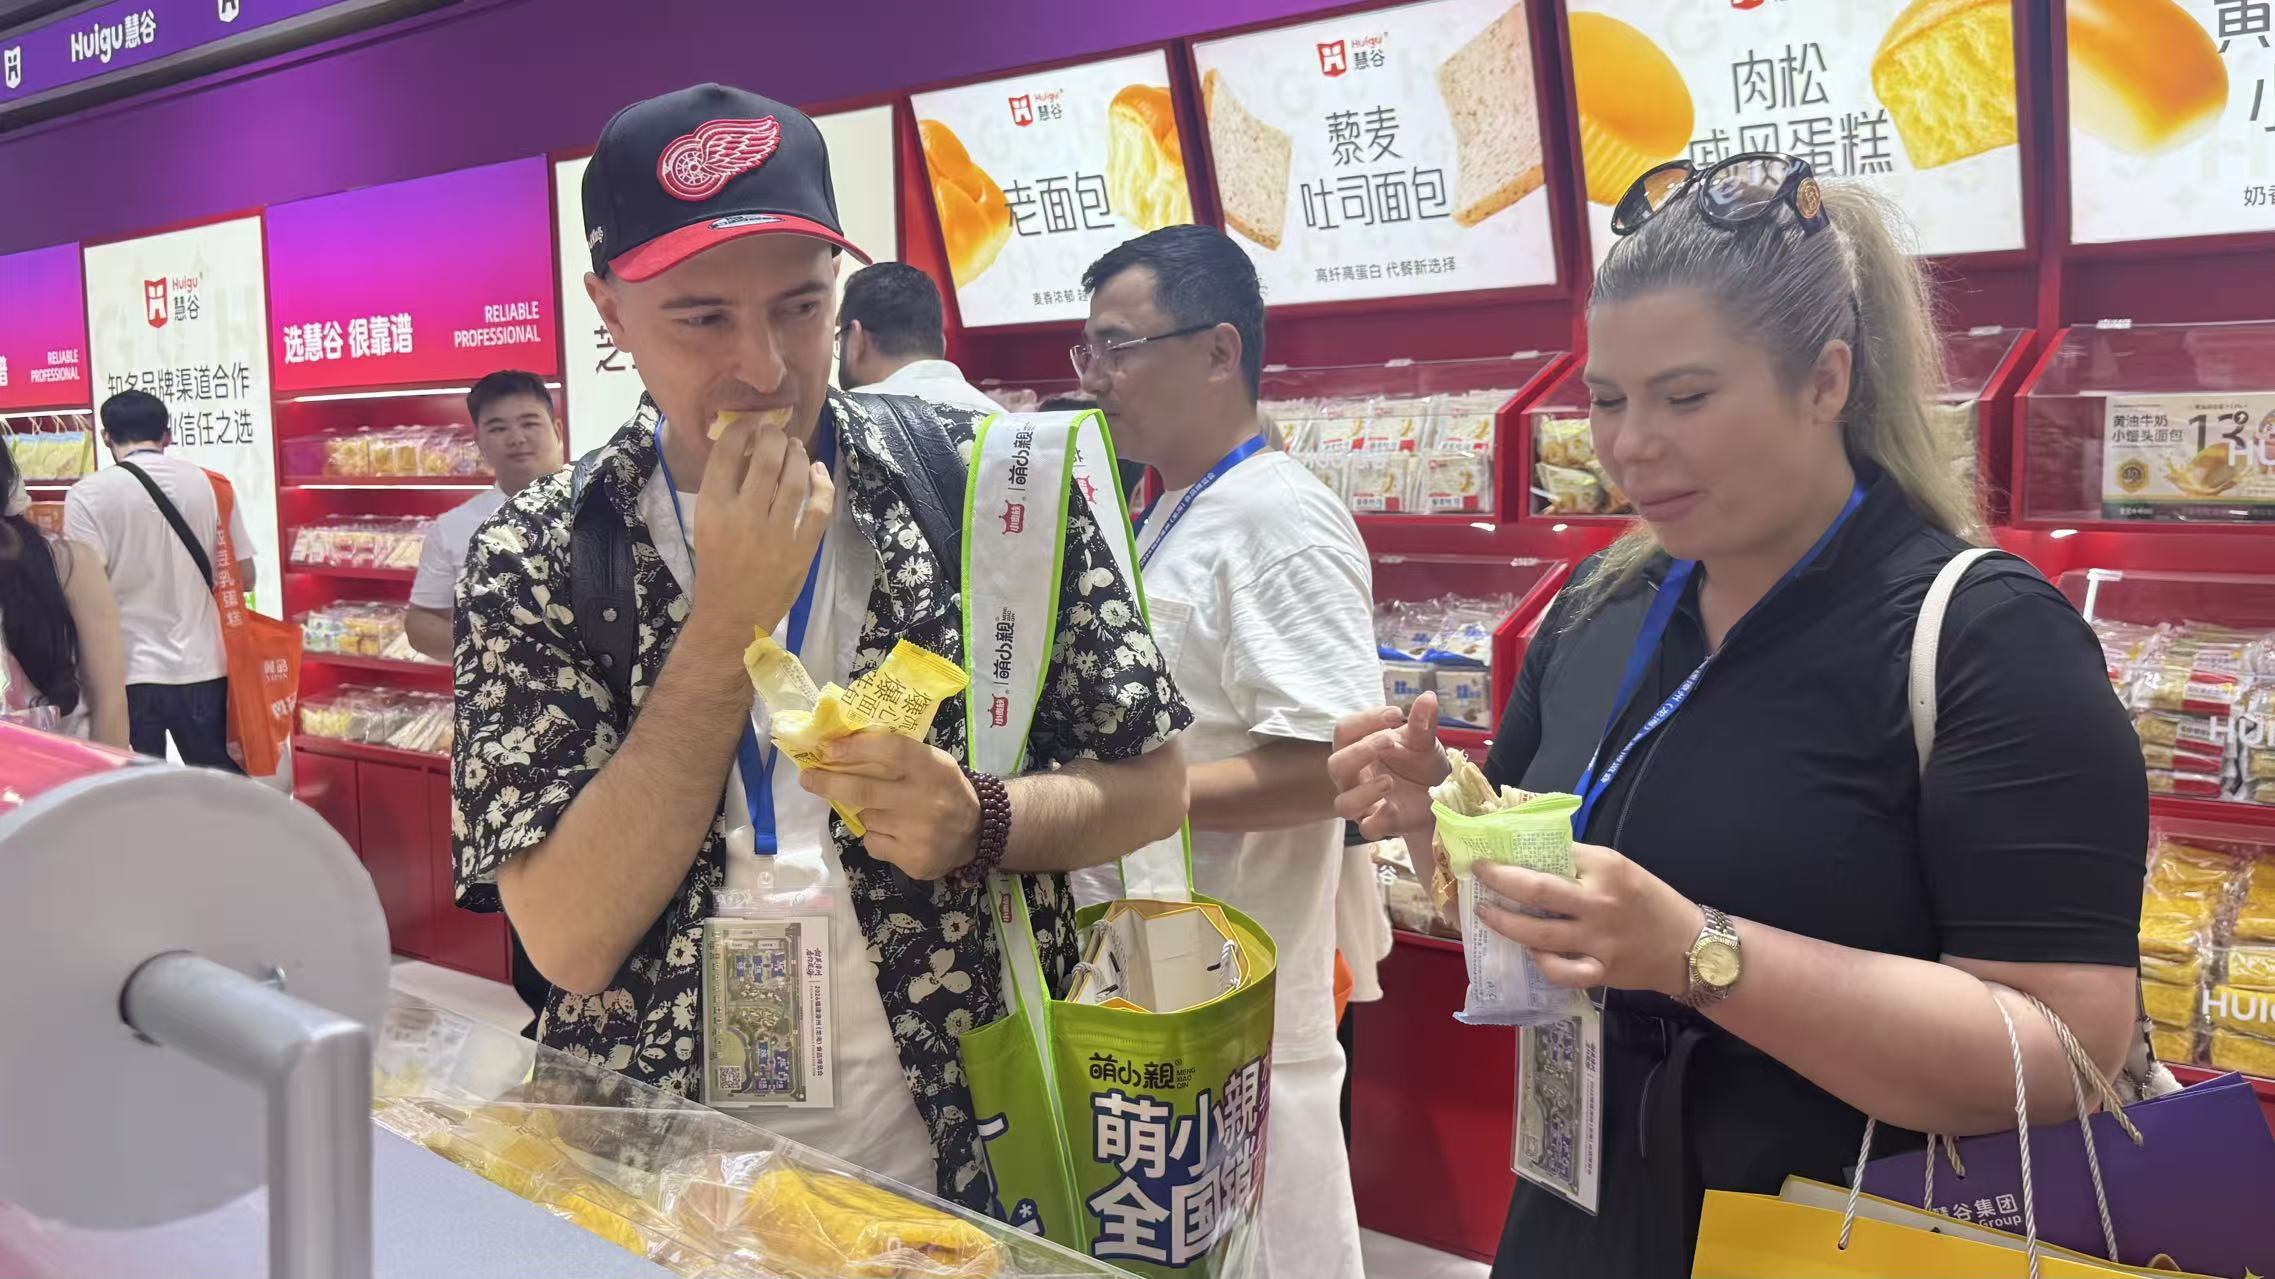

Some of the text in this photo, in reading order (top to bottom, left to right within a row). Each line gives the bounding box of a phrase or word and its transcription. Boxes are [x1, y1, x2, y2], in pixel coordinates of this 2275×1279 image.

[1351, 34, 1383, 49] Huigu
[1354, 50, 1385, 70] 慧谷
[1732, 42, 1829, 114] 肉松
[1038, 103, 1062, 121] 慧谷
[1325, 105, 1403, 166] 藜麦
[1003, 171, 1115, 236] 老面包
[1300, 166, 1450, 230] 吐司面包
[1314, 256, 1456, 283] 高纤高蛋白 代餐新选择
[172, 275, 198, 293] Huigu
[174, 294, 200, 321] 慧谷
[1033, 289, 1074, 306] 麦香浓郁
[484, 301, 539, 323] RELIABLE
[283, 313, 413, 364] 选慧谷 很靠谱
[454, 325, 541, 347] PROFESSIONAL
[47, 348, 79, 365] RELIABLE
[31, 366, 80, 383] PROFESSIONAL
[107, 361, 250, 402] 知名品牌渠道合作
[2113, 414, 2168, 428] 黄油牛奶
[2112, 428, 2183, 443] 小馒头面包
